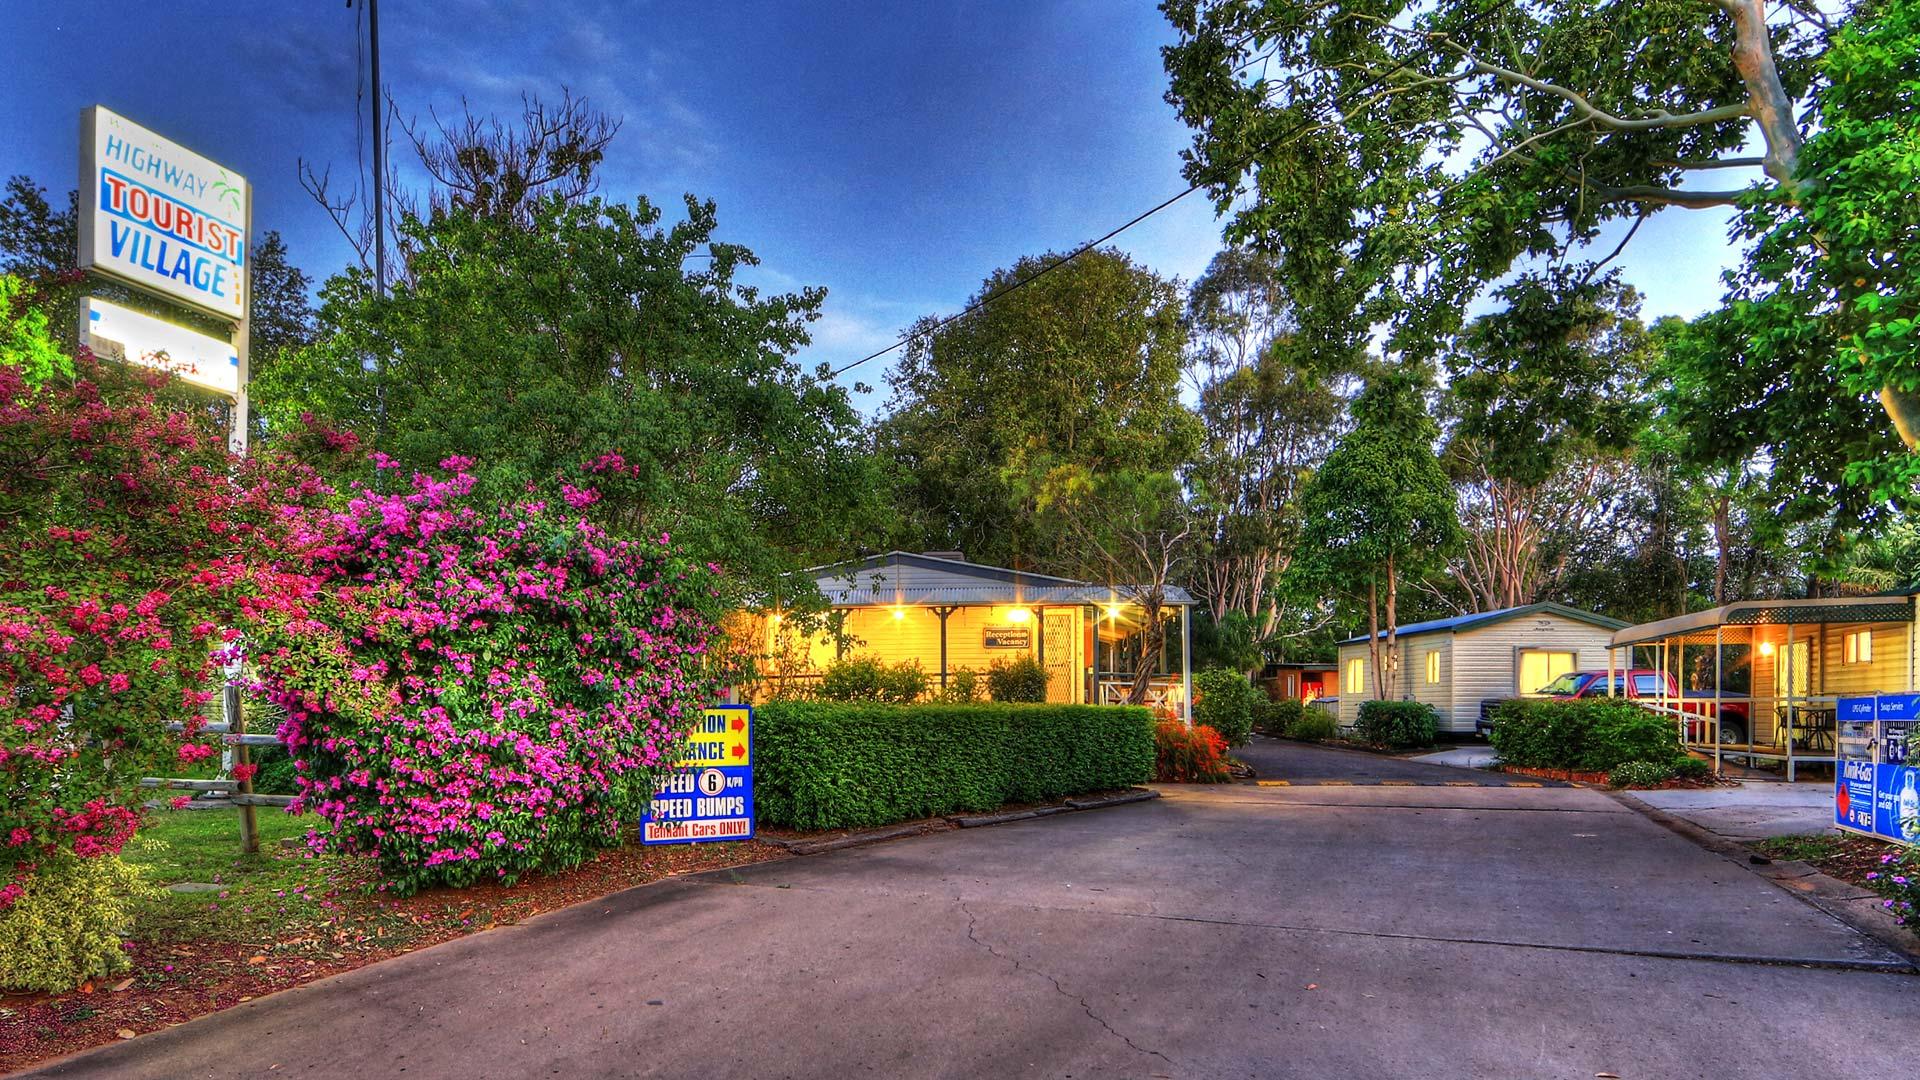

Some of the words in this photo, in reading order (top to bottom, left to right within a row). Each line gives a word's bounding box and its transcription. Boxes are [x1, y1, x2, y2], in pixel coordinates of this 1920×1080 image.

[105, 133, 208, 199] HIGHWAY
[107, 177, 240, 260] TOURIST
[110, 219, 227, 298] VILLAGE
[997, 638, 1028, 647] Vacancy
[1891, 702, 1904, 711] Service
[708, 774, 717, 792] 6
[651, 798, 692, 819] SPEED
[697, 796, 745, 817] BUMPS
[648, 823, 688, 839] Tennant
[692, 823, 717, 837] Cars
[719, 821, 746, 835] ONLY!
